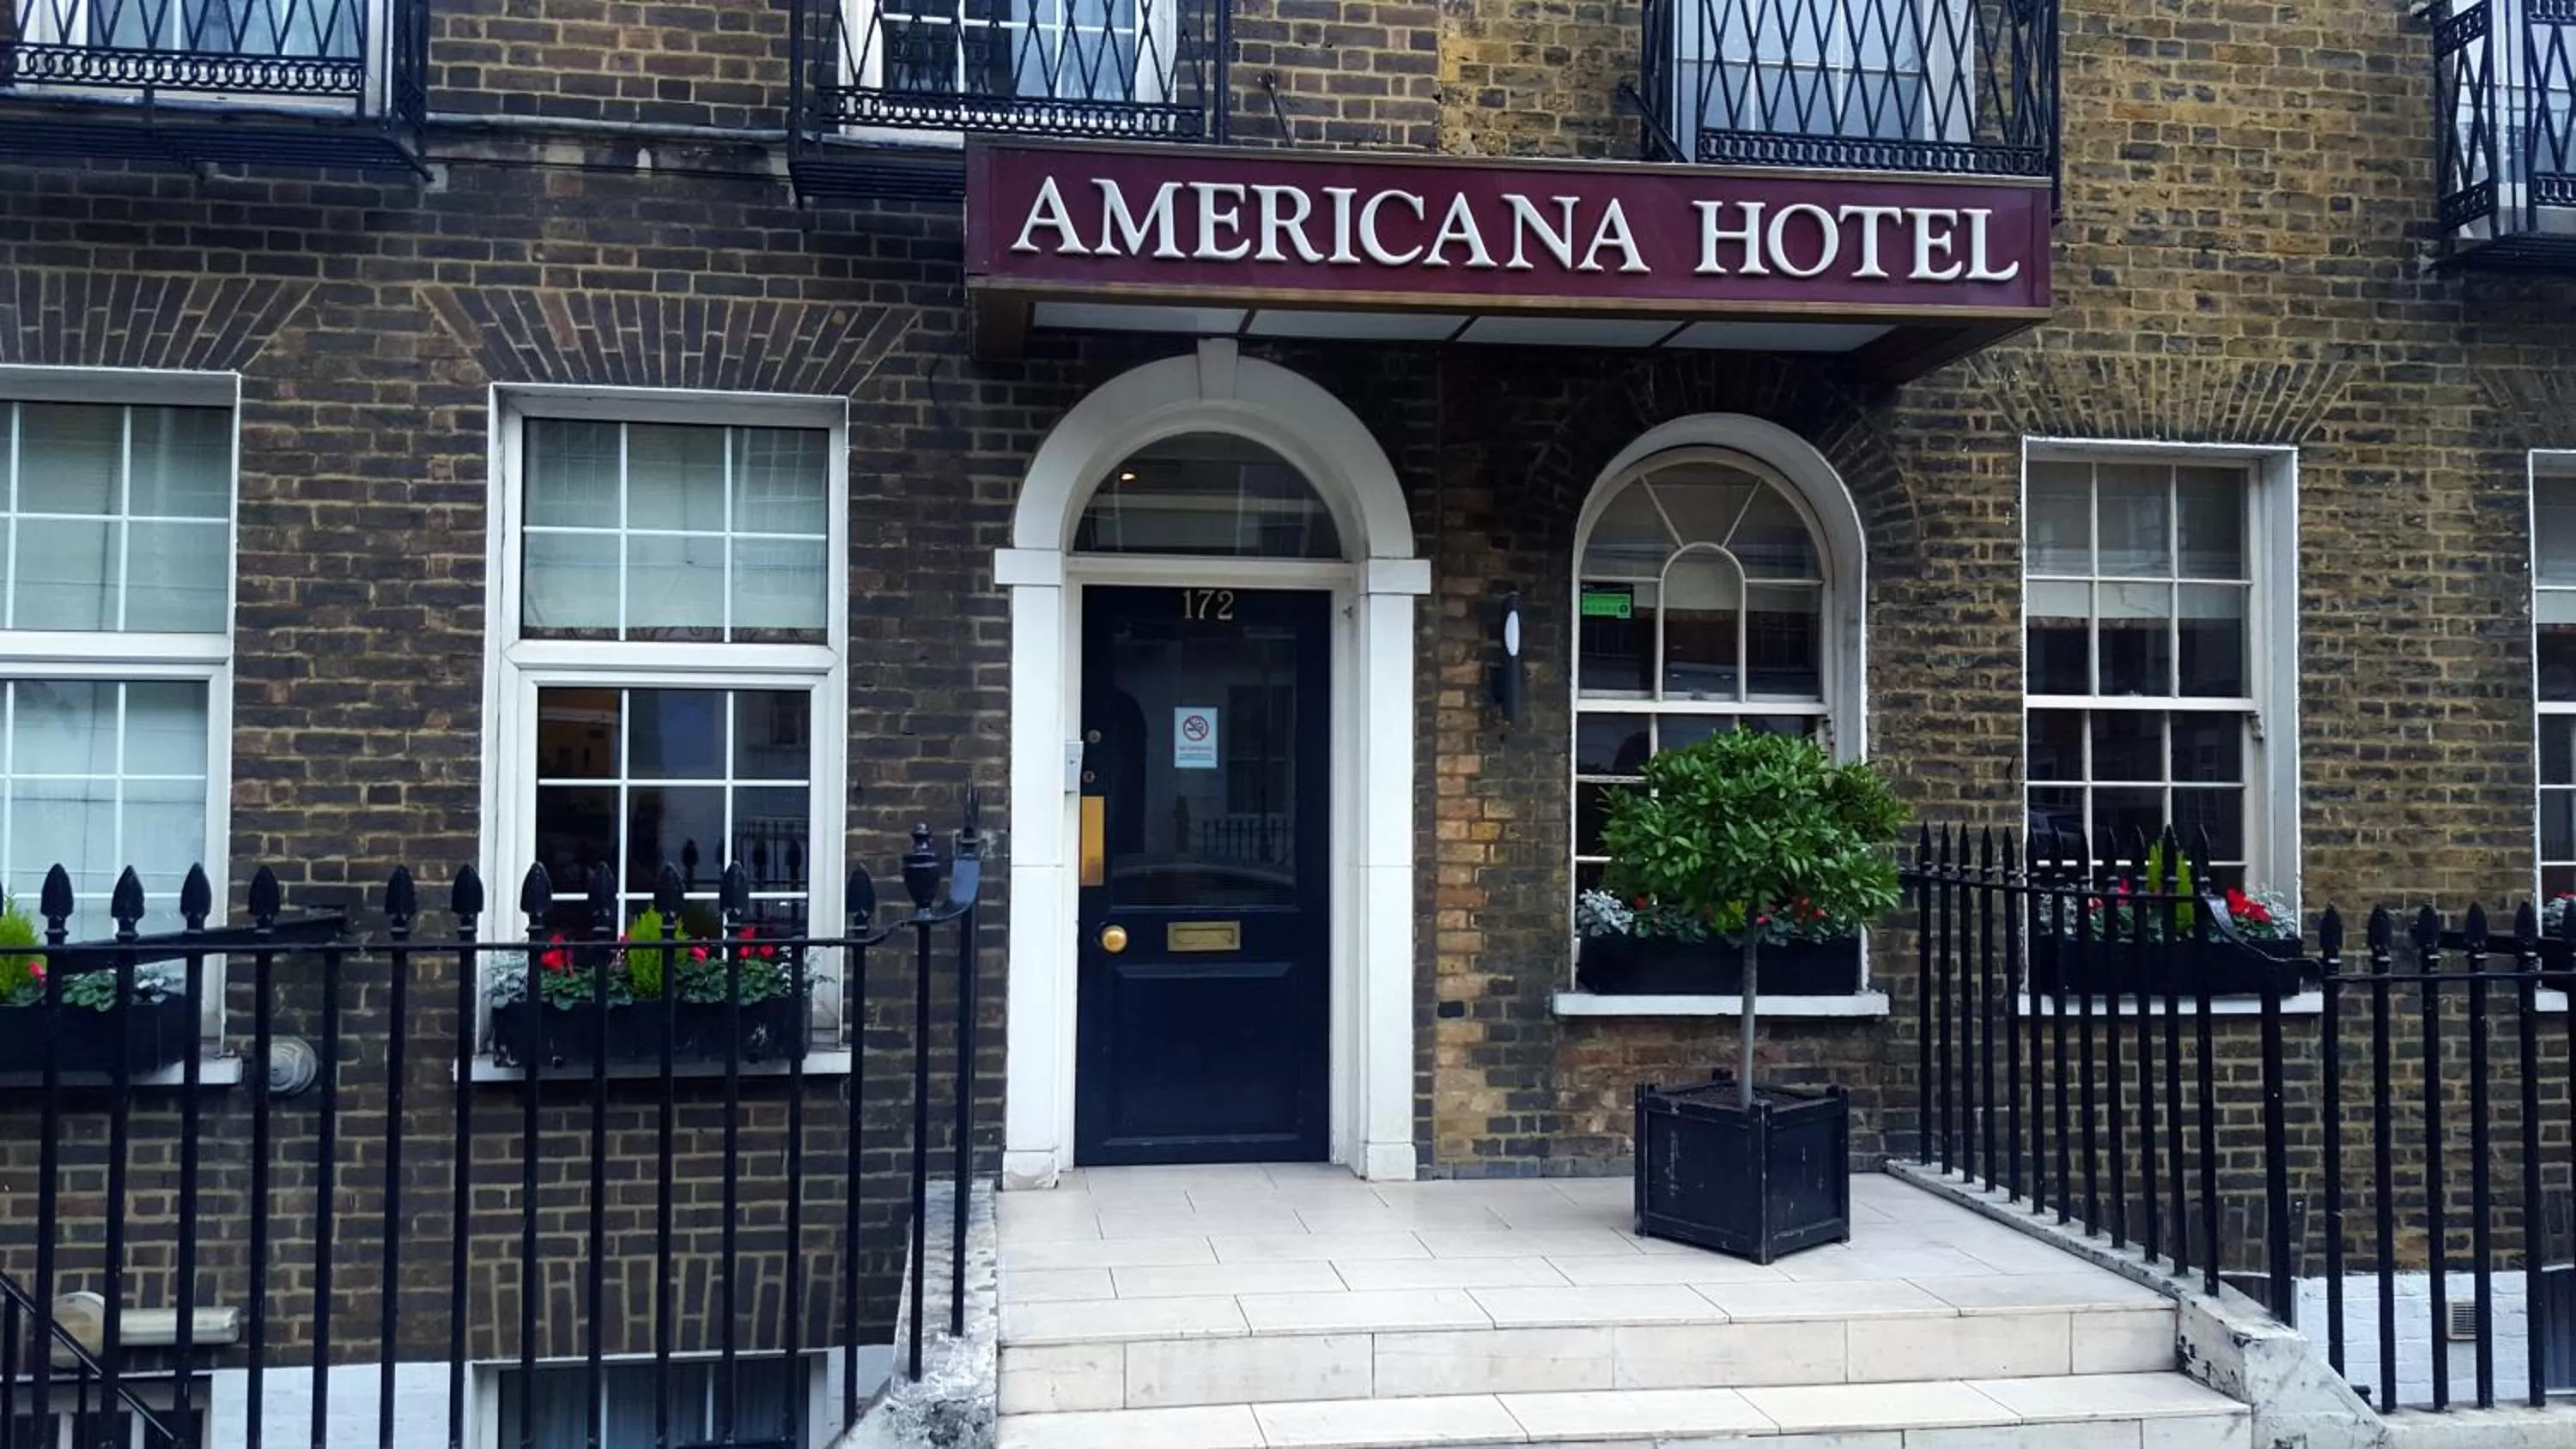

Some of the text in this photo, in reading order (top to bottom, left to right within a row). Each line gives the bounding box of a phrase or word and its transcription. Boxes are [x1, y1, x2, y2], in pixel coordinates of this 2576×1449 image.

[1011, 175, 2020, 282] AMERICANA HOTEL
[1183, 590, 1234, 620] 172
